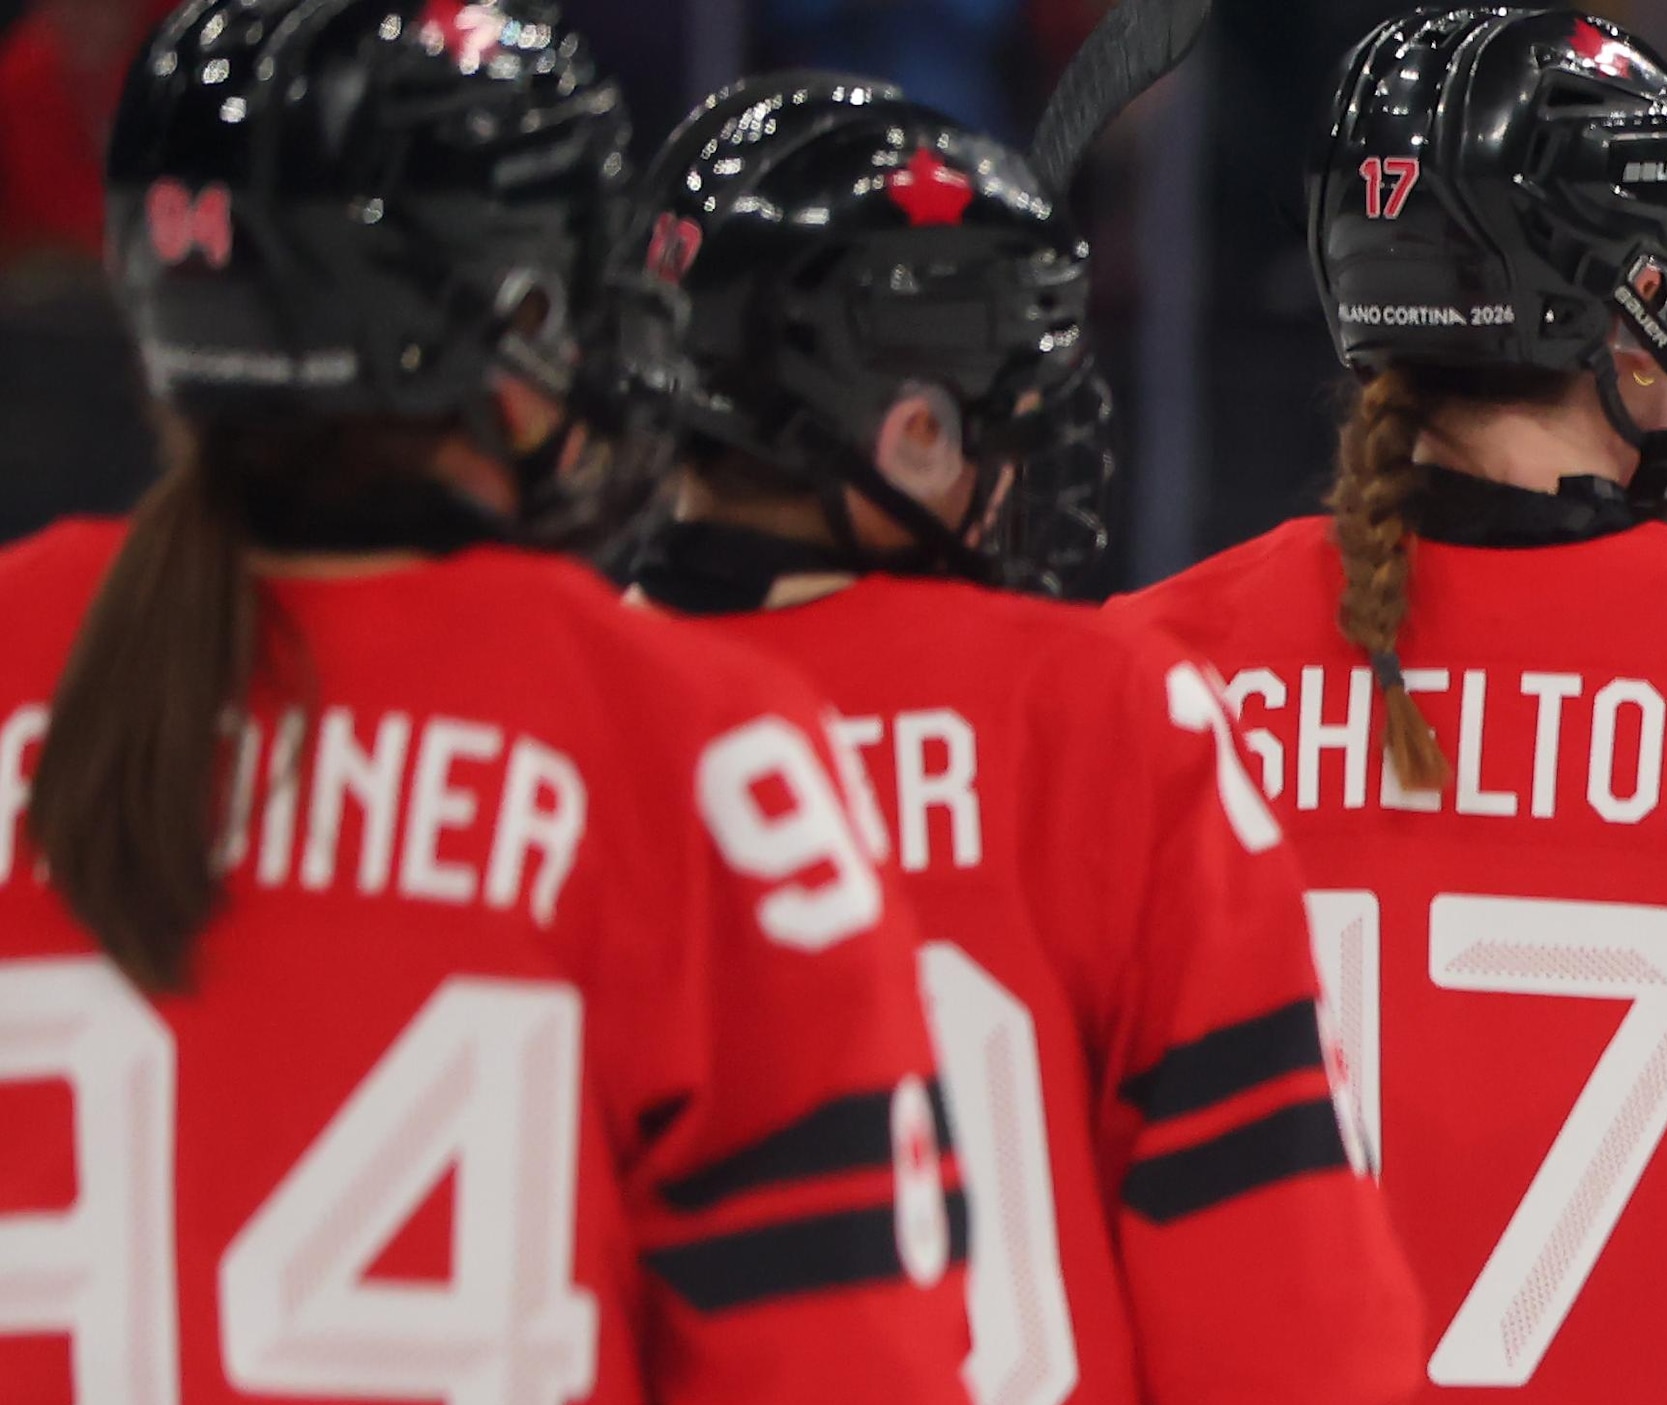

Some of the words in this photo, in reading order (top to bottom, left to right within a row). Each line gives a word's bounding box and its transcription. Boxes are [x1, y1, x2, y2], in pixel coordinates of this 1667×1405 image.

[1359, 157, 1420, 219] 17
[1383, 305, 1467, 326] CORTINA
[1470, 306, 1515, 325] 2026
